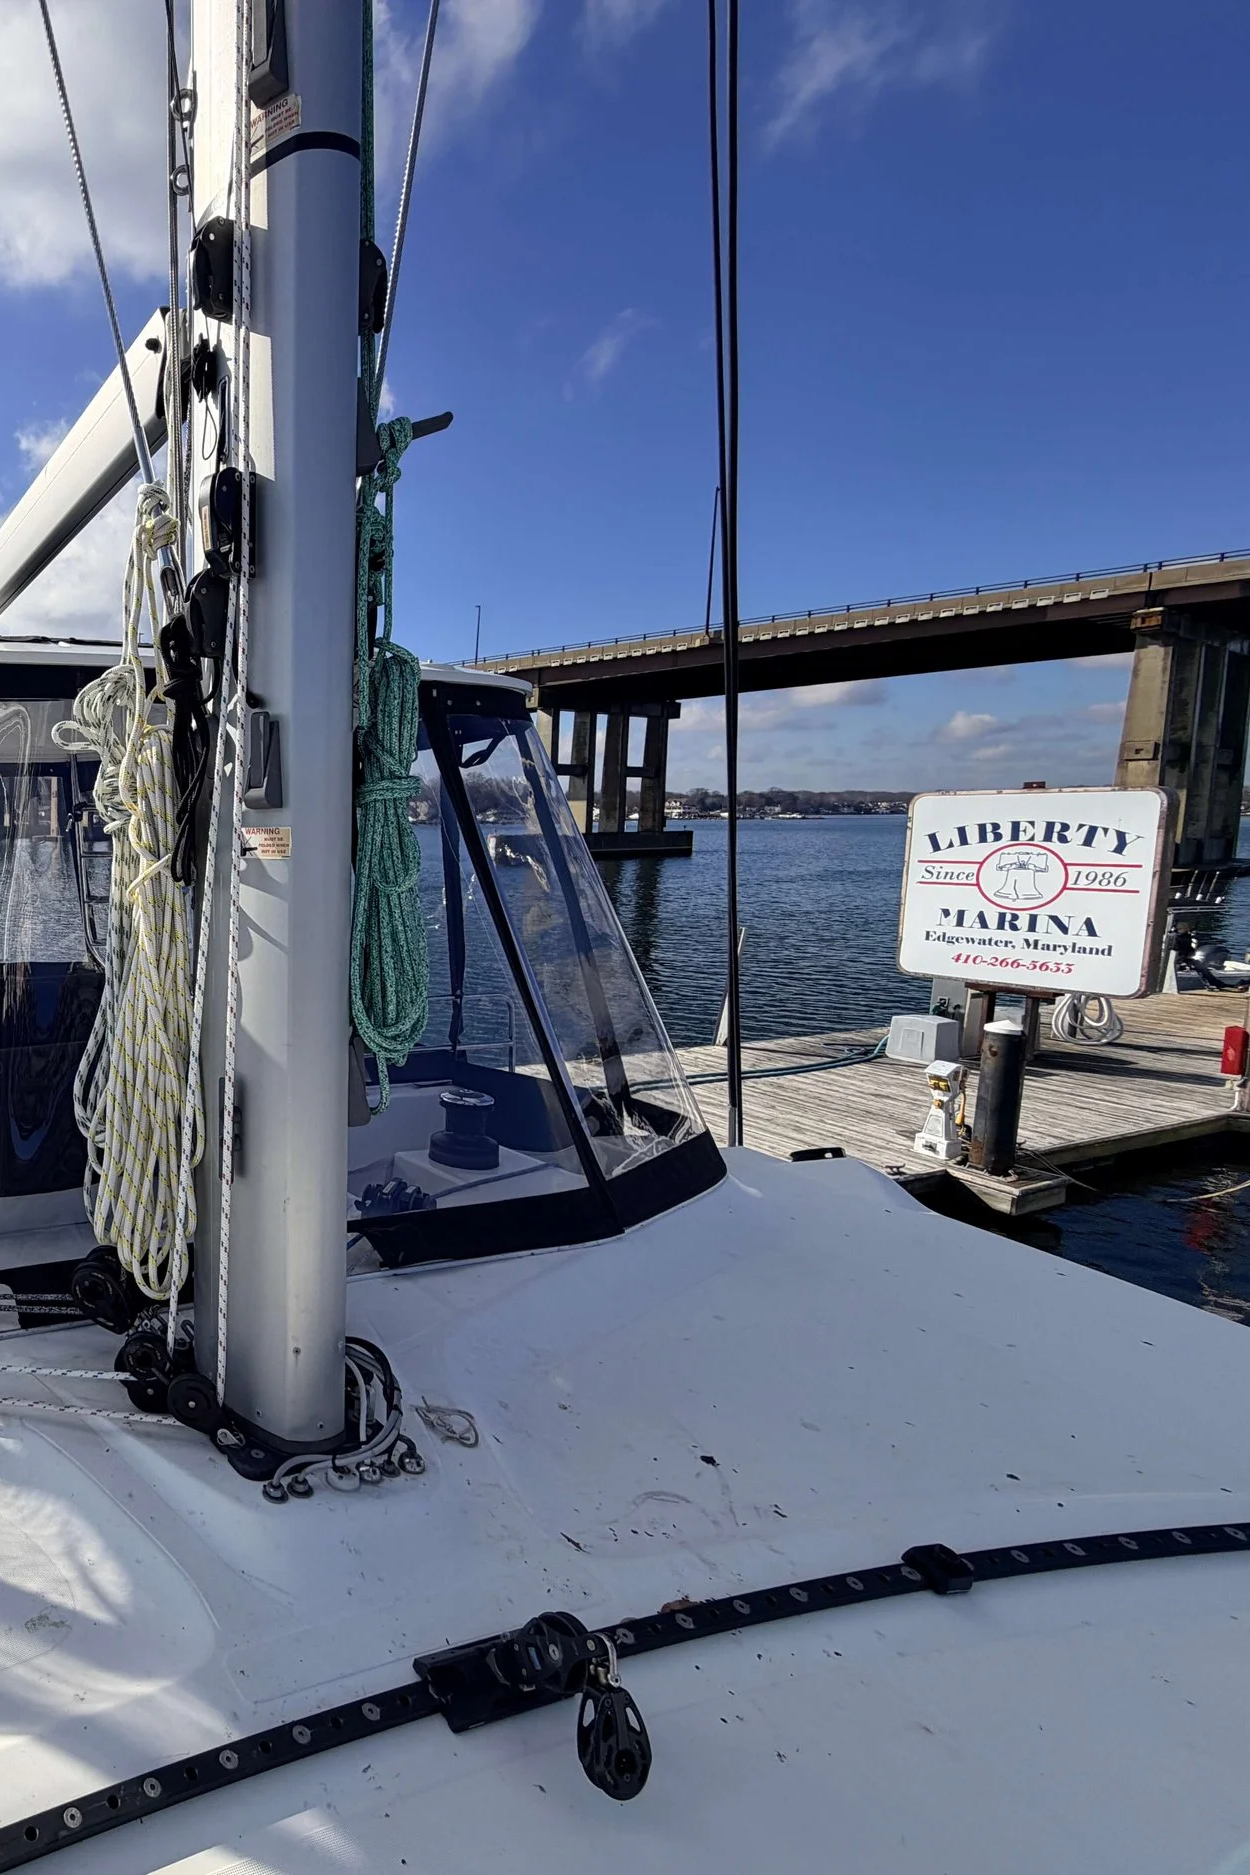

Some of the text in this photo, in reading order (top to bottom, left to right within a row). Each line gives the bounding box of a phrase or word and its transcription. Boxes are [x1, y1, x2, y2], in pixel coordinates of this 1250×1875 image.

[245, 827, 280, 835] WARNING
[924, 820, 1145, 856] LIBERTY
[921, 865, 1129, 888] Since 1986
[936, 908, 1101, 938] MARINA
[925, 930, 1113, 956] Edgewater, Maryland
